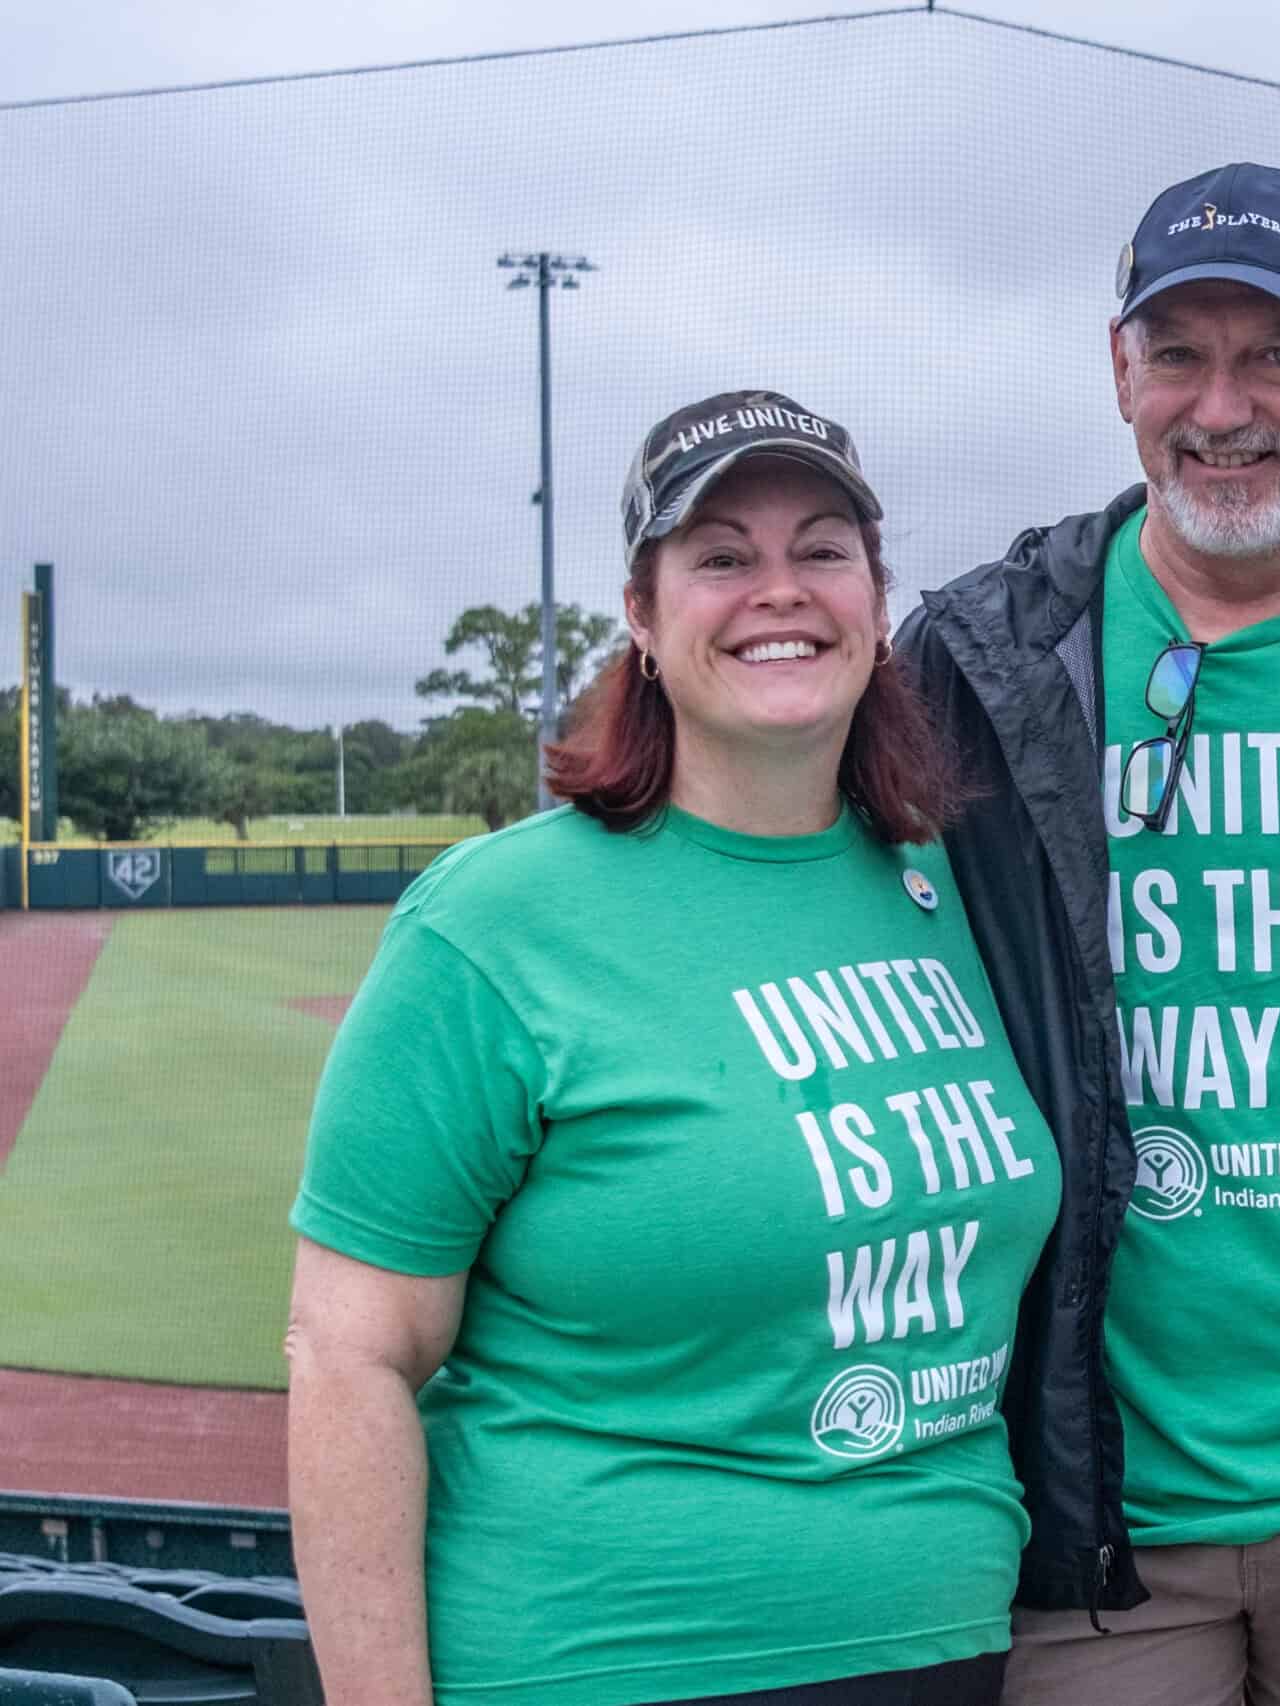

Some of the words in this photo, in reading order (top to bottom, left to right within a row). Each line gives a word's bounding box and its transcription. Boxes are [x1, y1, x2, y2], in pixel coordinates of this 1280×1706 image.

[1168, 216, 1201, 236] THE
[678, 415, 732, 453] LIVE
[736, 407, 829, 441] UNITED
[116, 854, 153, 884] 42
[1107, 868, 1182, 974] IS
[731, 957, 985, 1081] UNITED
[1115, 1005, 1280, 1110] WAY
[794, 1102, 894, 1217] IS
[885, 1079, 1035, 1195] THE
[826, 1219, 980, 1350] WAY
[911, 1355, 990, 1406] UNITED
[914, 1412, 967, 1440] Indian
